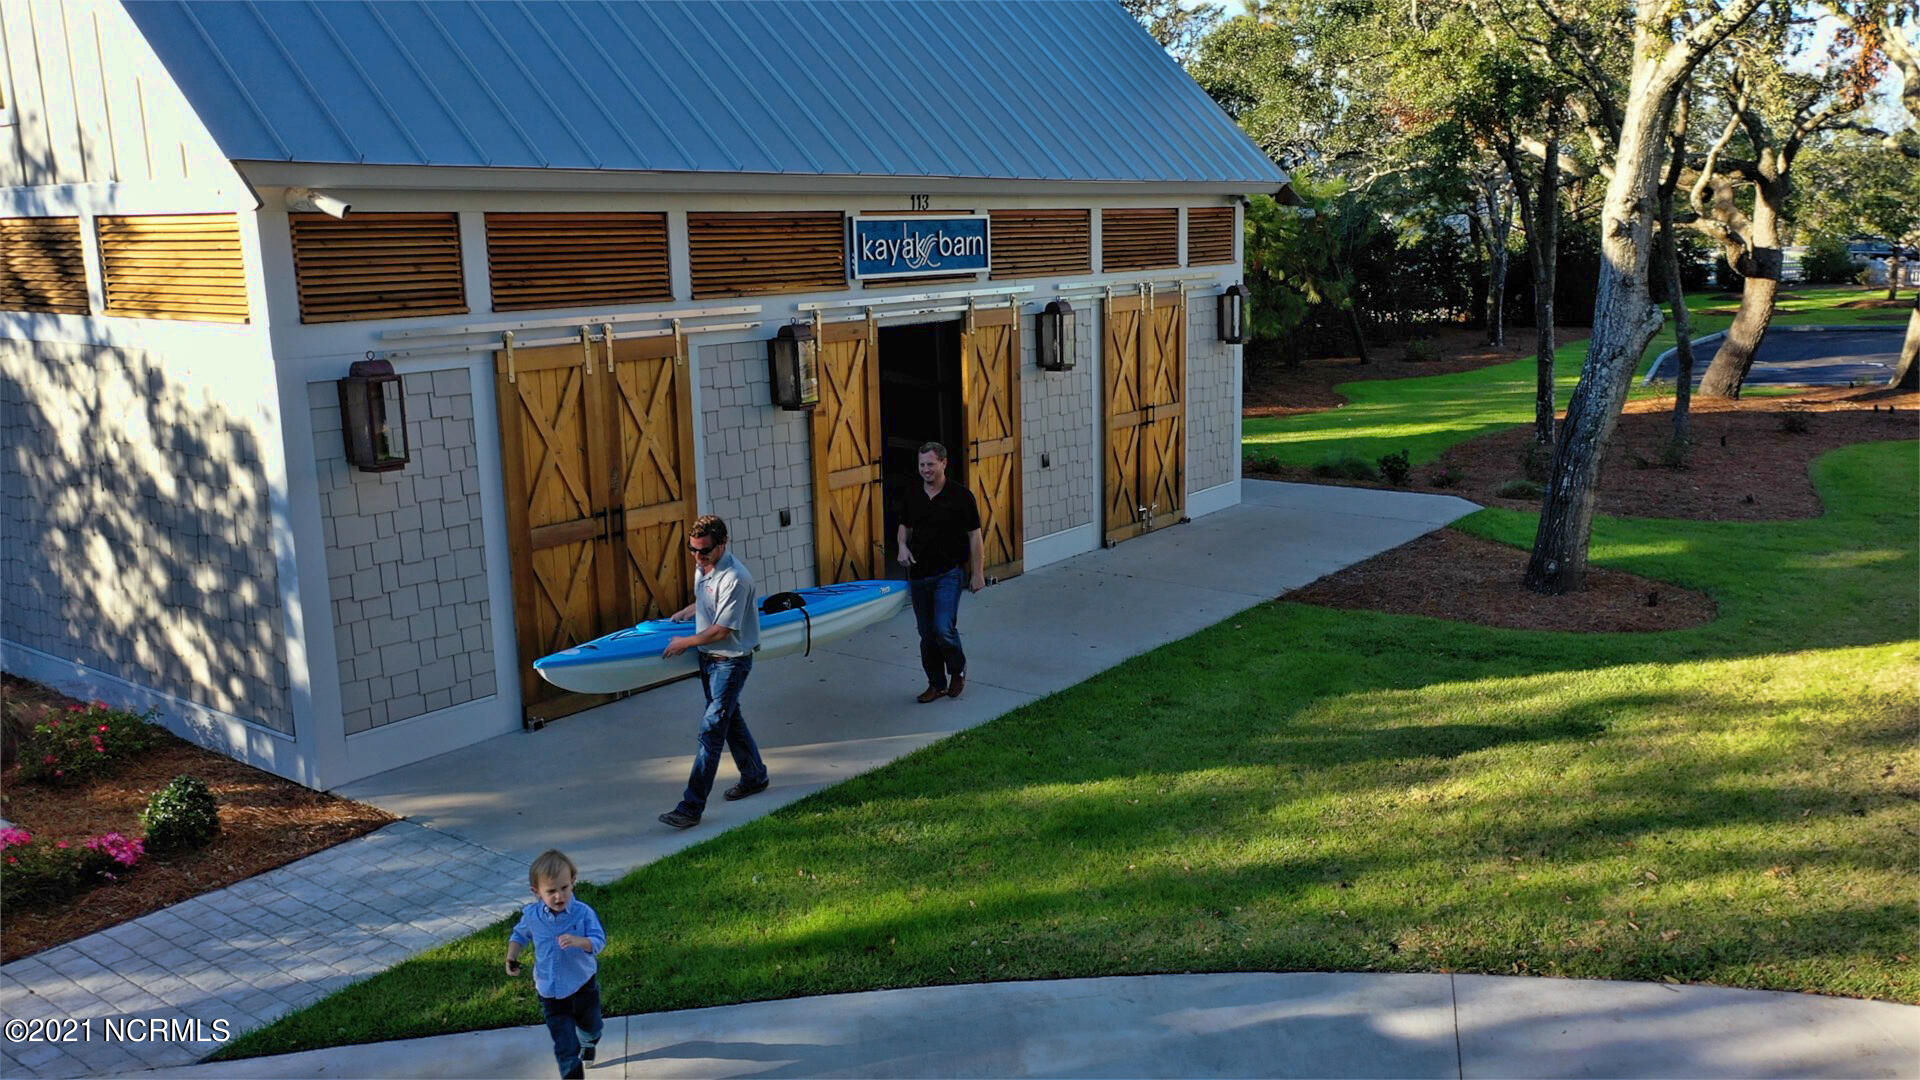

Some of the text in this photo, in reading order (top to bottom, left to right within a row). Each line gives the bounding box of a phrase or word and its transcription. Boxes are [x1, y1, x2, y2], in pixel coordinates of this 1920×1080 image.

[910, 194, 929, 211] 113
[861, 229, 984, 267] kayak barn
